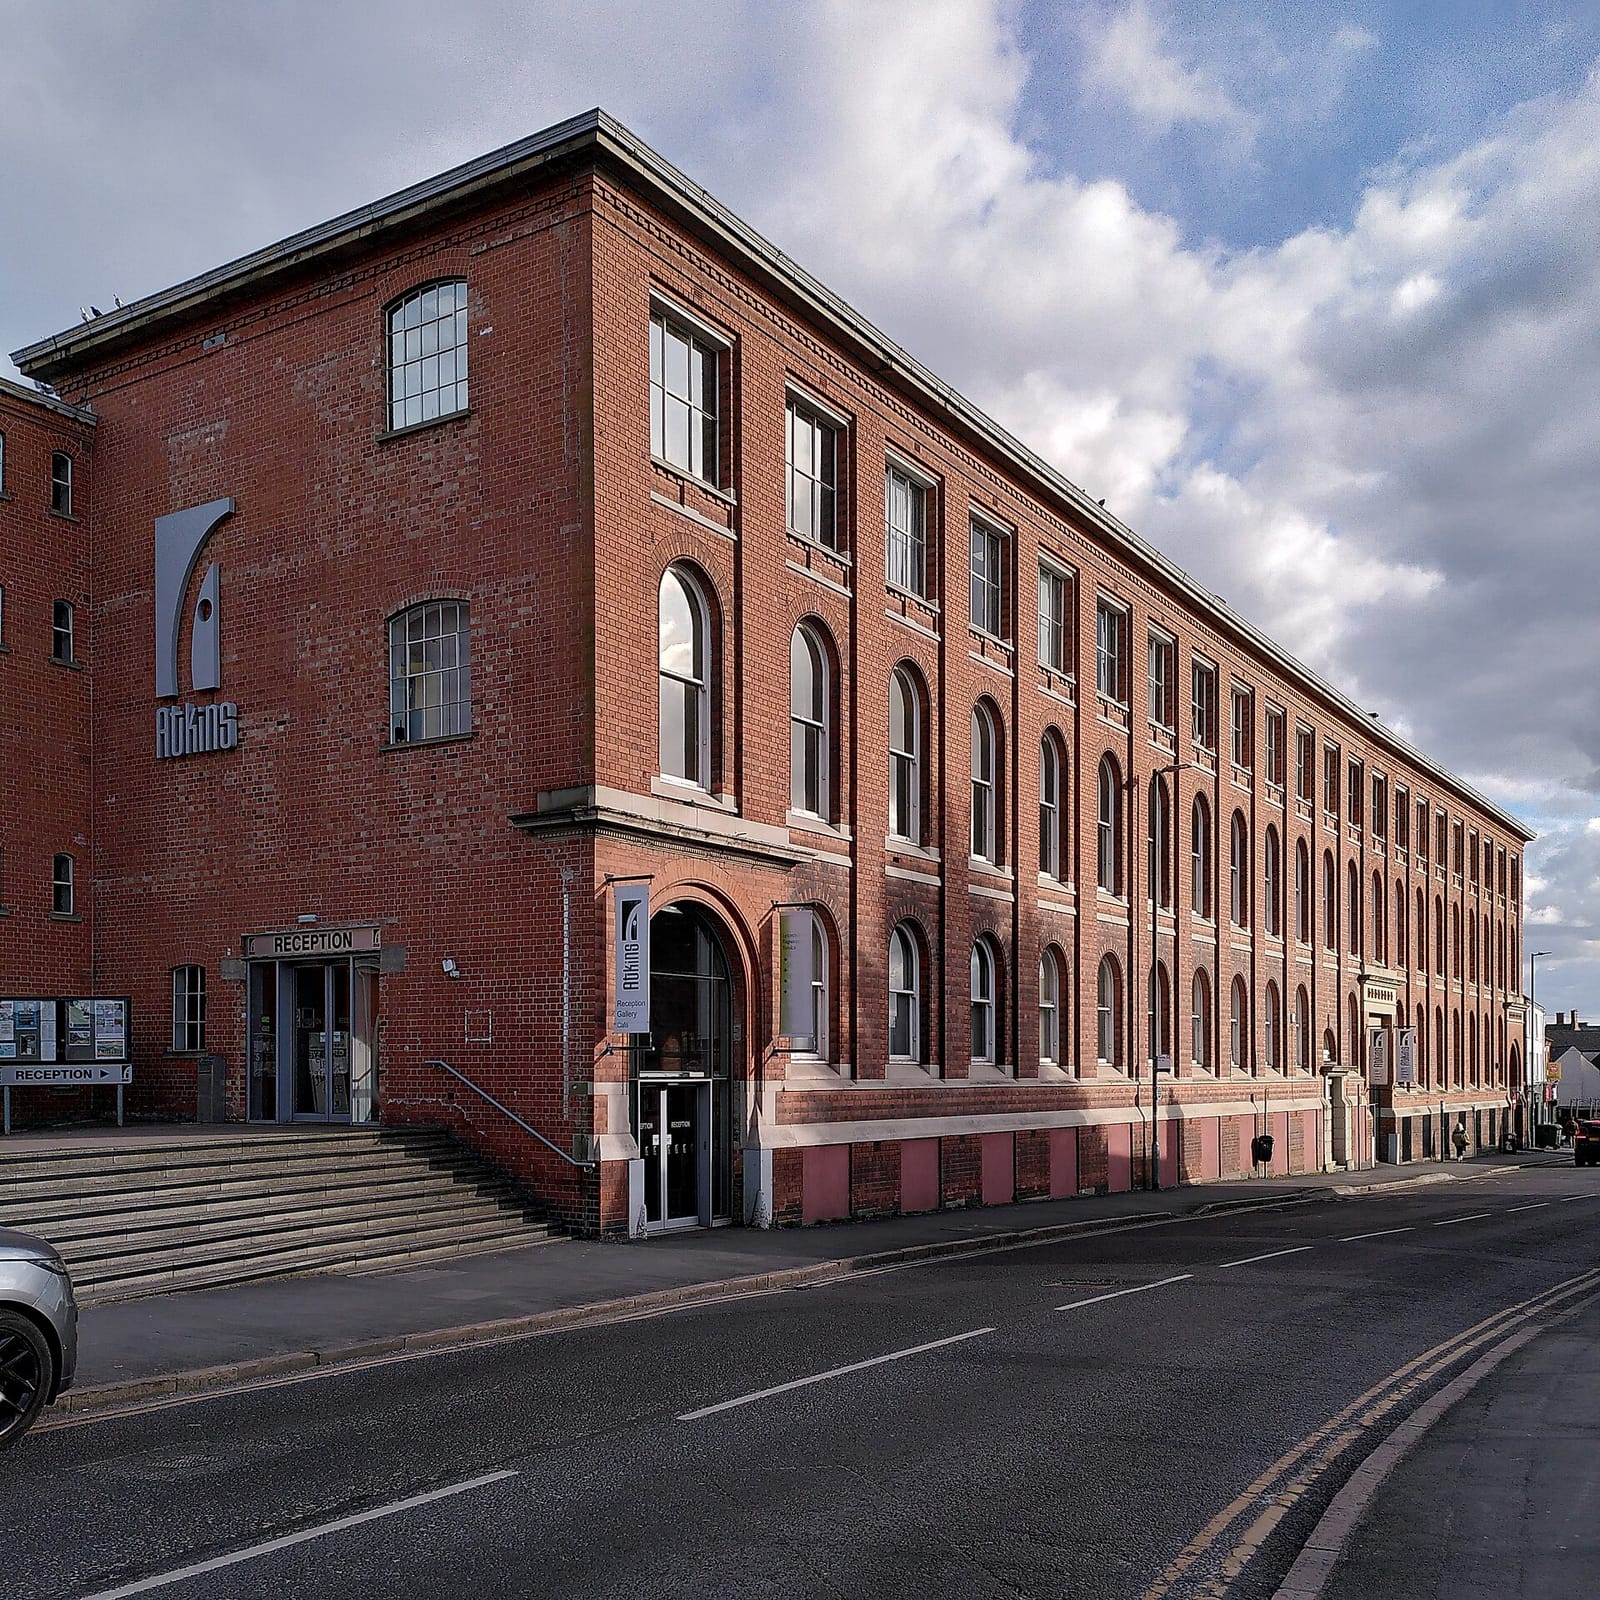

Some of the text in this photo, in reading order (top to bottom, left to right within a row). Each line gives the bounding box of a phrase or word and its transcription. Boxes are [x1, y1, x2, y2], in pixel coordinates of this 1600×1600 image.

[156, 701, 238, 758] Atkins
[274, 932, 353, 953] RECEPTION
[623, 943, 640, 991] Atkins
[616, 999, 646, 1009] Reception
[616, 1010, 638, 1019] Gallery
[15, 1069, 93, 1081] RECEPTION
